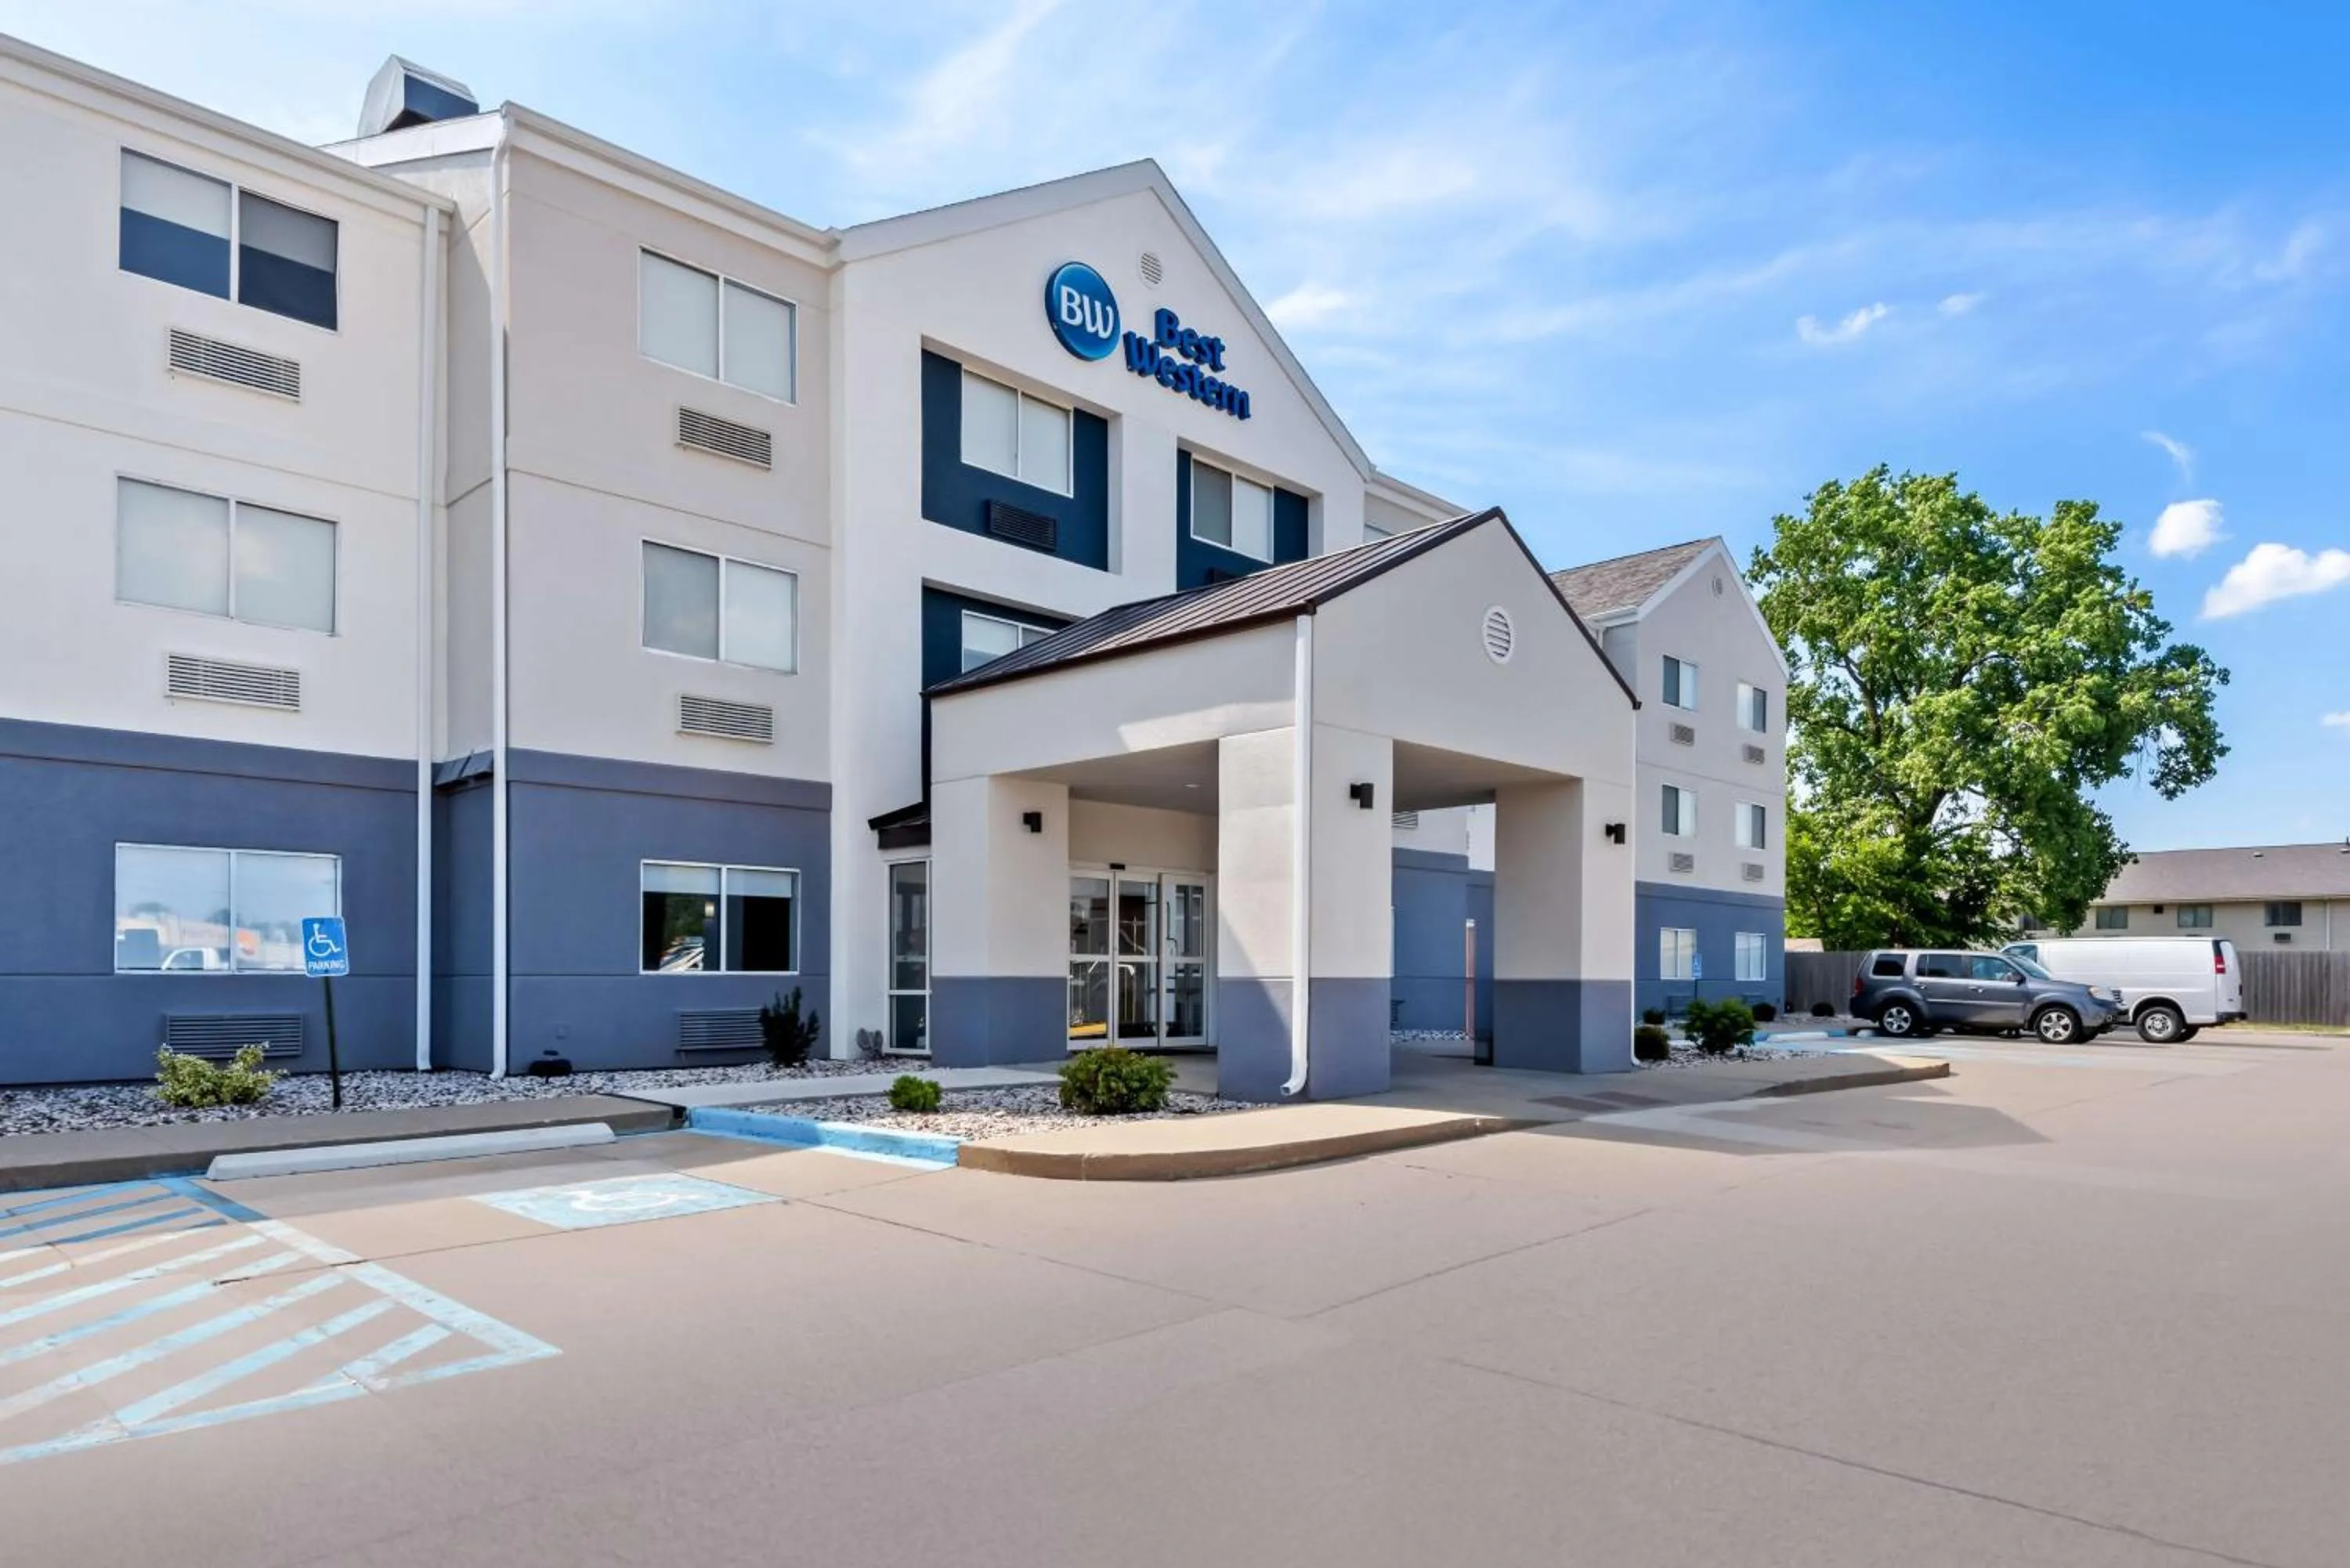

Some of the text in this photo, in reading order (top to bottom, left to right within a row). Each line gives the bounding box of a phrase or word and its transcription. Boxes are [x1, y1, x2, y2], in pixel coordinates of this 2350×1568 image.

[1060, 285, 1114, 339] BW
[1154, 308, 1226, 373] Best
[1123, 331, 1251, 421] Western
[308, 960, 345, 970] PARKING
